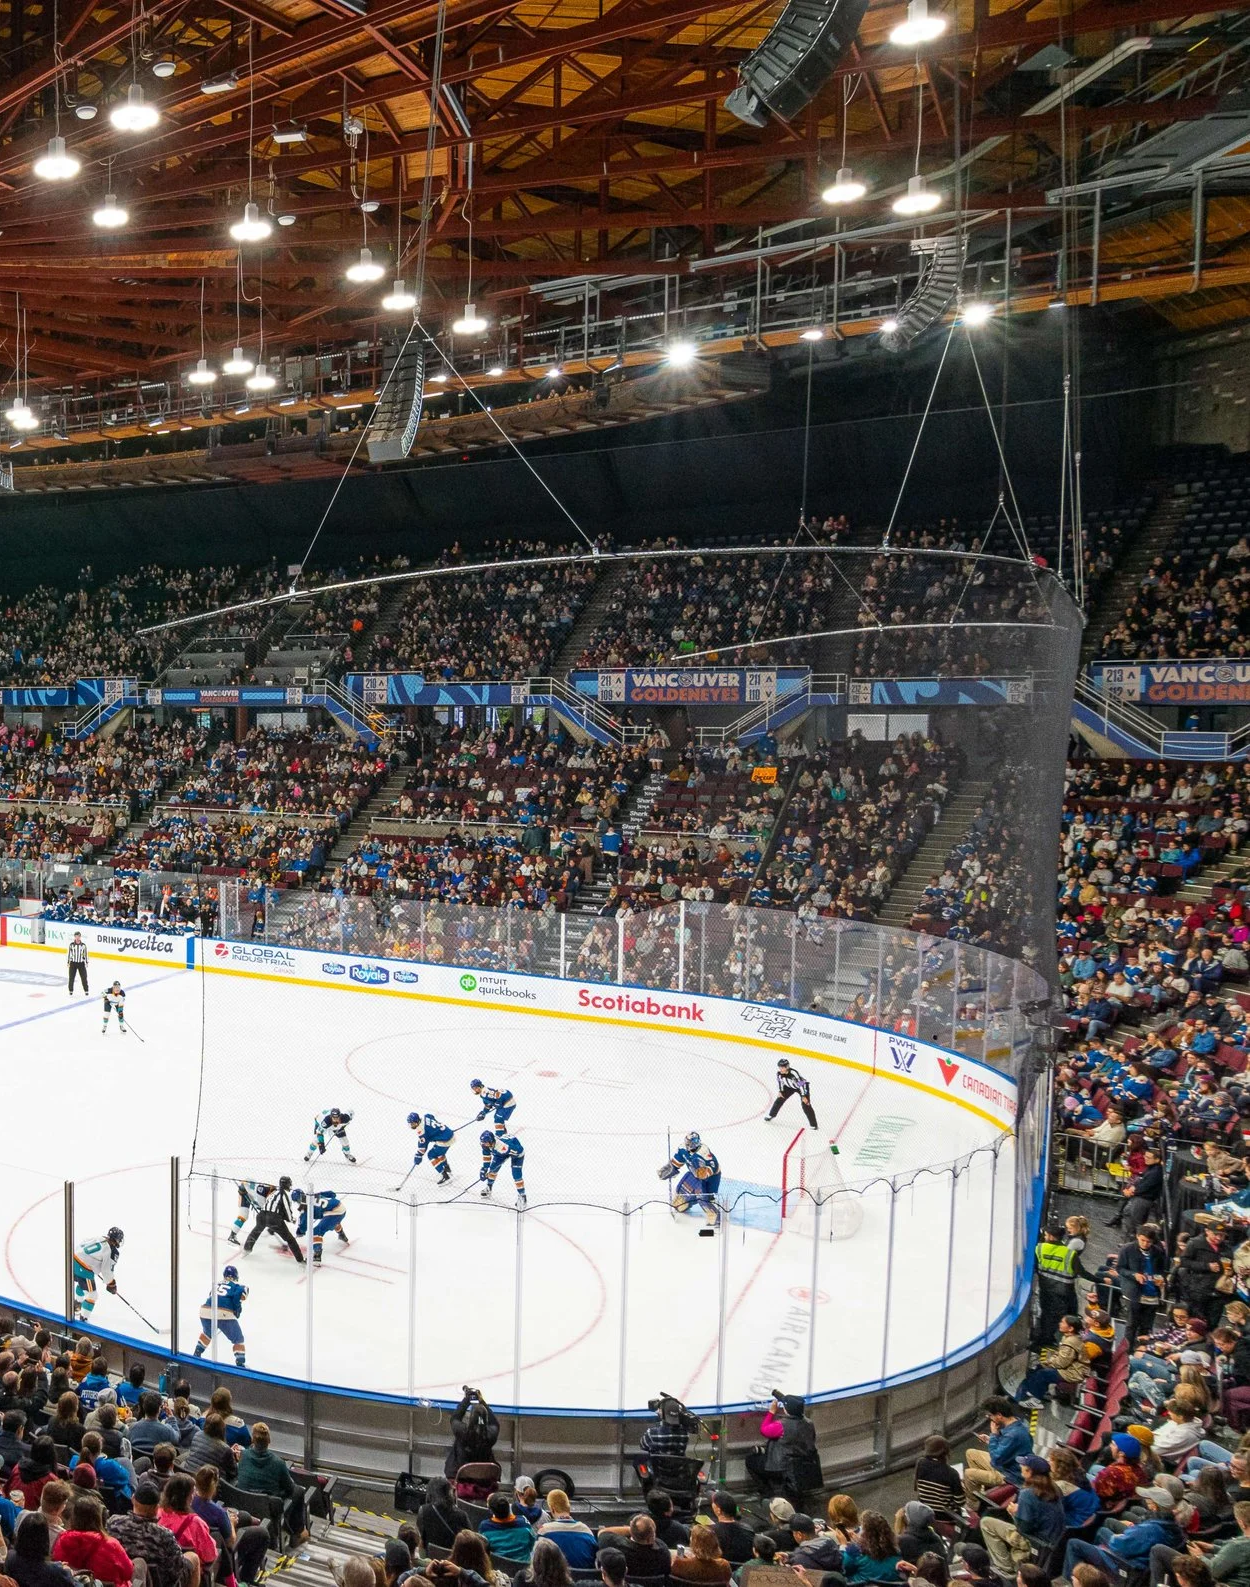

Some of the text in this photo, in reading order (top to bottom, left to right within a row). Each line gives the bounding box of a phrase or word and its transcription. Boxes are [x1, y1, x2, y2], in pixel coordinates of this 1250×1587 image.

[601, 676, 611, 686] 211
[632, 673, 740, 687] VANCOUVER
[750, 674, 761, 686] 211
[1106, 670, 1123, 682] 213
[366, 678, 376, 688] 210
[601, 690, 612, 700] 109
[631, 688, 739, 701] GOLDENEYES
[97, 935, 121, 944] DRINK
[118, 935, 173, 952] peeltea
[232, 946, 295, 960] GLOBAL
[232, 954, 295, 967] INDUSTRIAL
[324, 965, 344, 974] Royale
[352, 968, 387, 982] Royale
[395, 973, 416, 982] Royale
[479, 986, 536, 999] quickbooks
[578, 989, 704, 1021] Scotiabank
[740, 1006, 796, 1030] Hockey
[803, 1028, 817, 1037] RAISE
[819, 1031, 833, 1040] YOUR
[889, 1036, 918, 1051] PWHL
[963, 1074, 1002, 1106] CANADIAN
[780, 1306, 810, 1334] AIR
